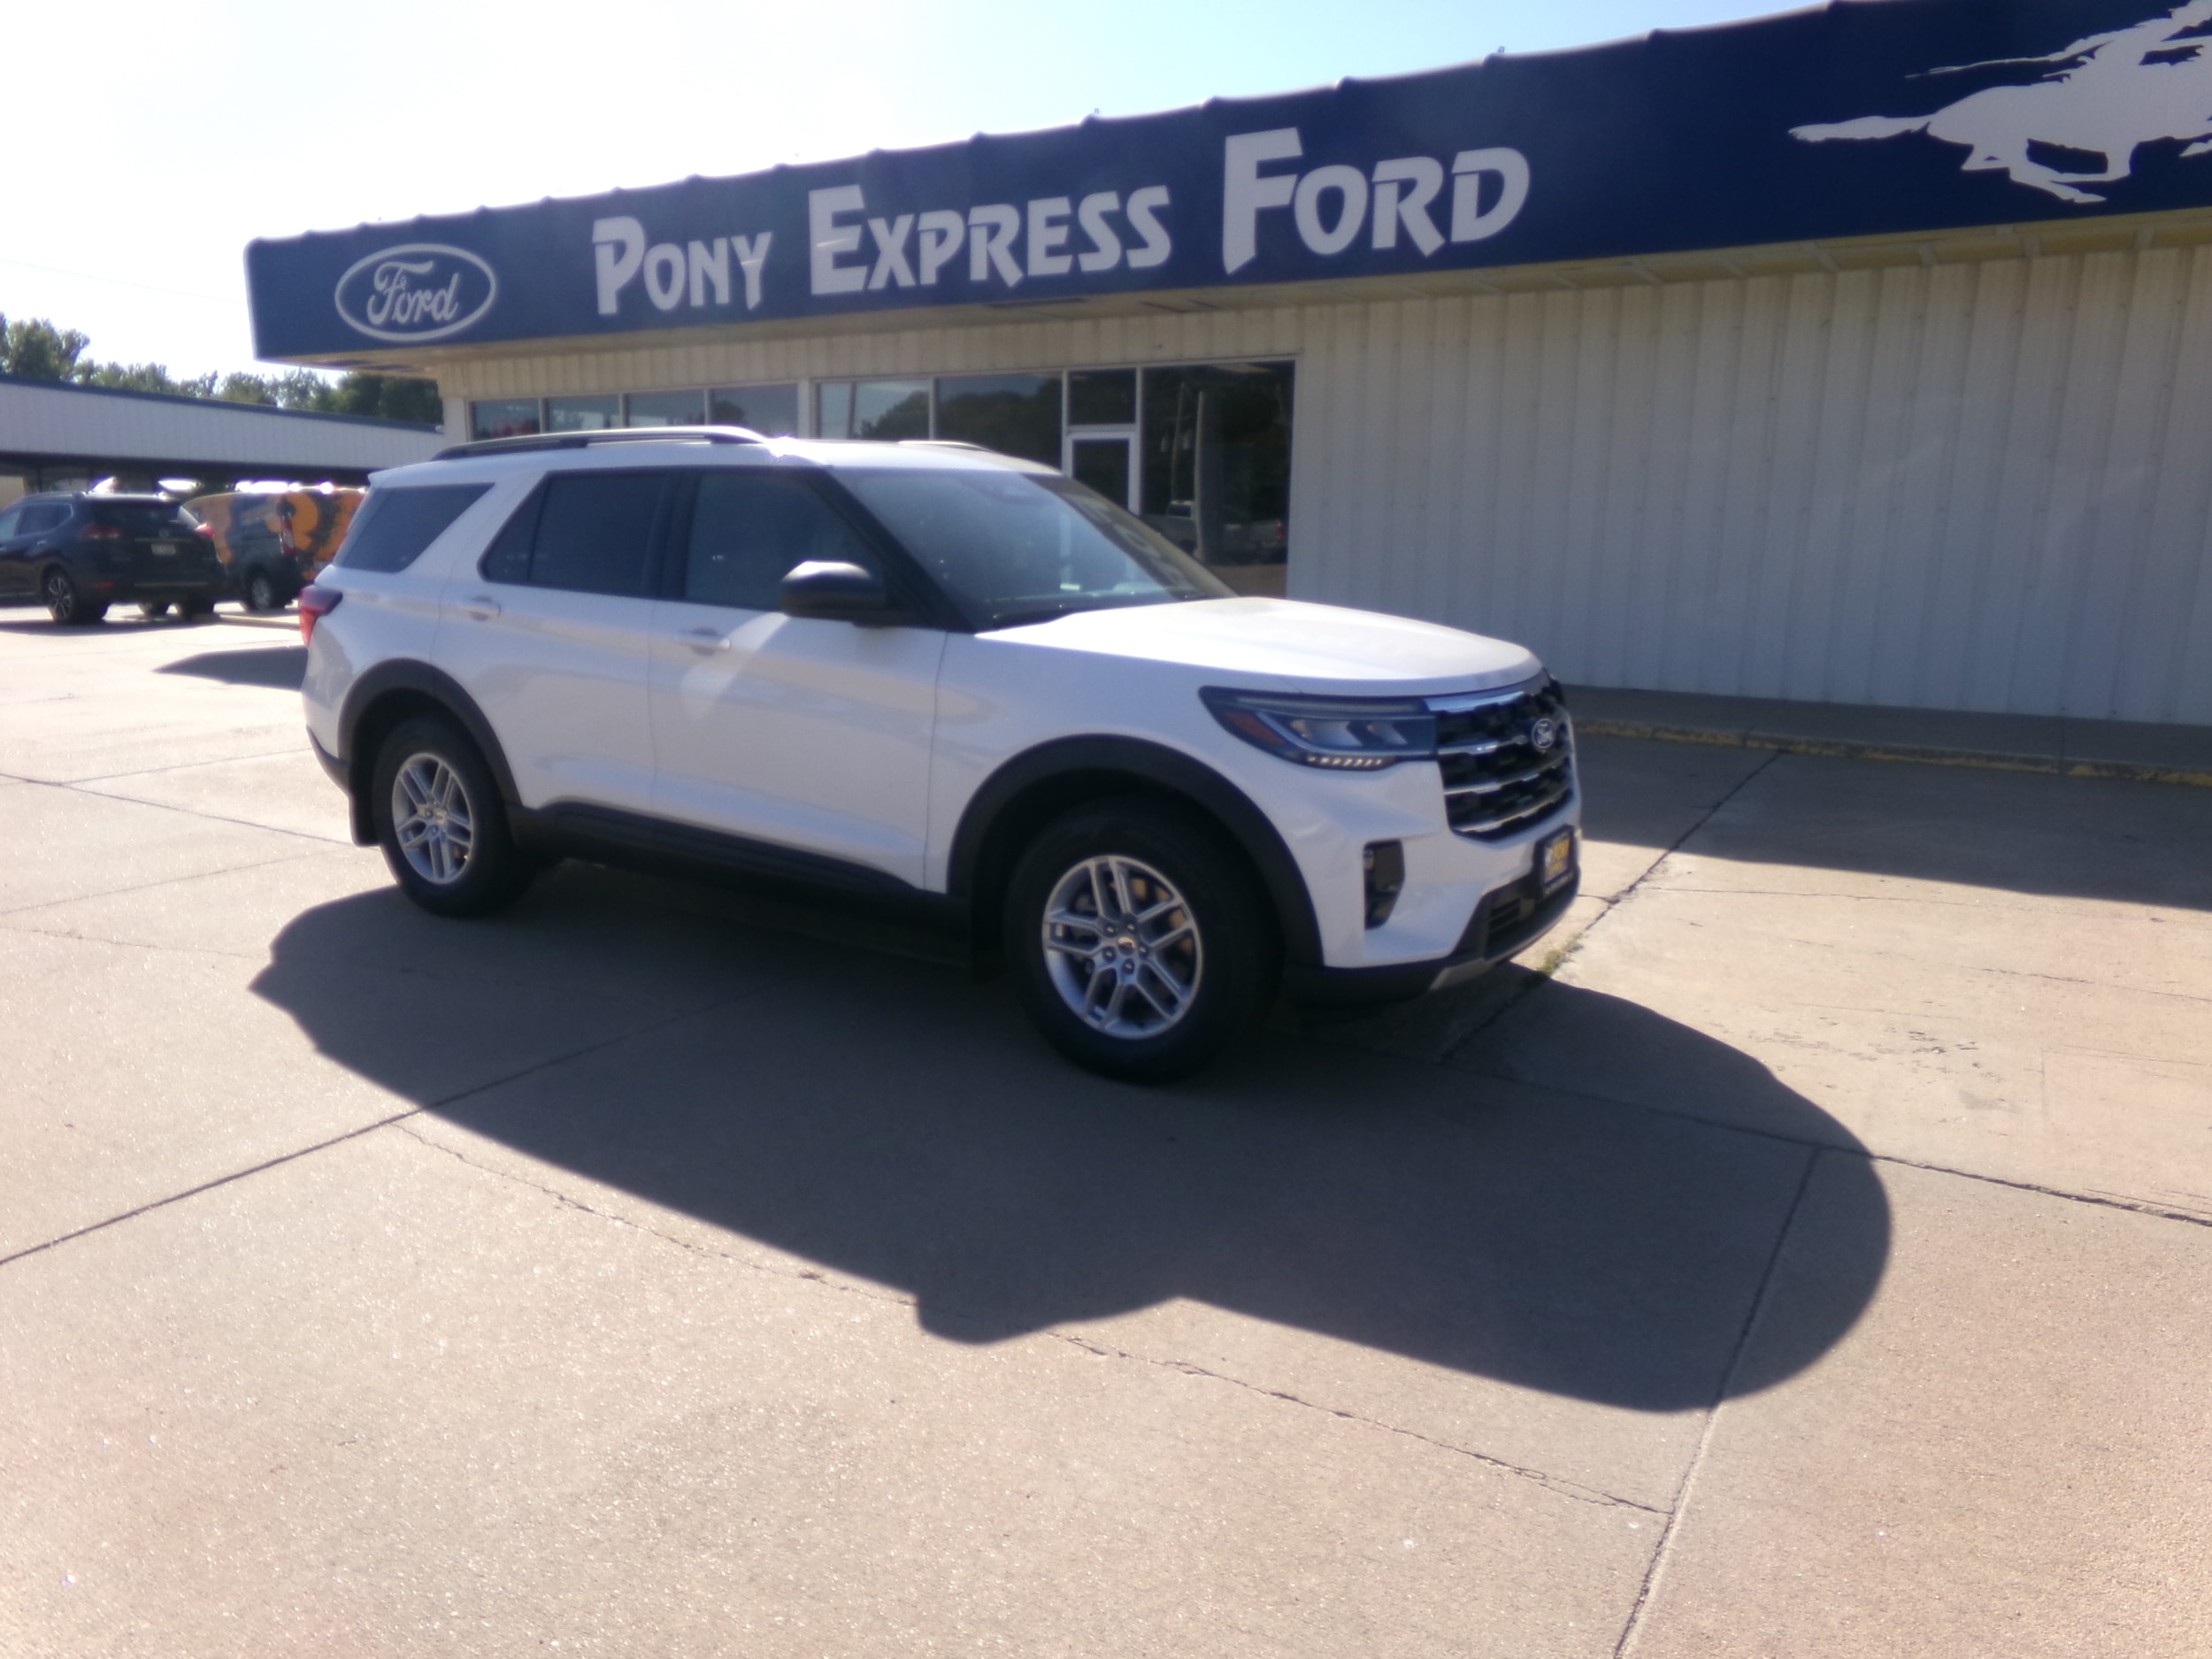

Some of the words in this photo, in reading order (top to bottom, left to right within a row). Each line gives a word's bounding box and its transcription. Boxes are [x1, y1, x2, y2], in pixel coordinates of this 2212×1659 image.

[592, 216, 772, 314] PONY
[809, 184, 1171, 296] EXPRESS
[1223, 127, 1531, 274] FORD
[367, 261, 458, 326] Ford
